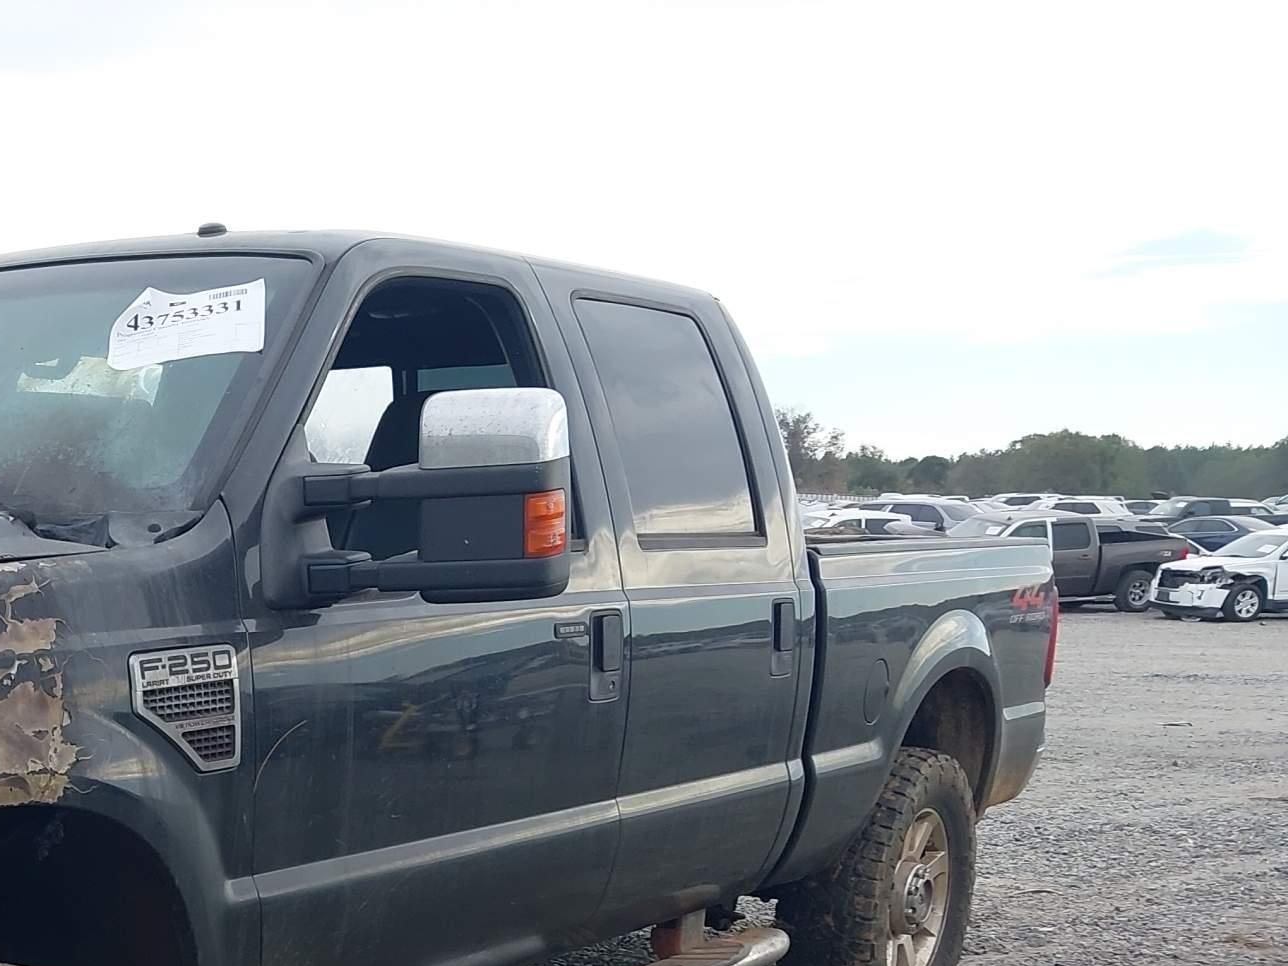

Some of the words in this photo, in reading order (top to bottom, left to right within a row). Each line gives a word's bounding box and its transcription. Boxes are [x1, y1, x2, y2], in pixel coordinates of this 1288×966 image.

[126, 299, 243, 332] 43753331
[142, 679, 170, 688] LARIAT
[186, 673, 212, 683] SUPER
[213, 670, 233, 679] DUTY
